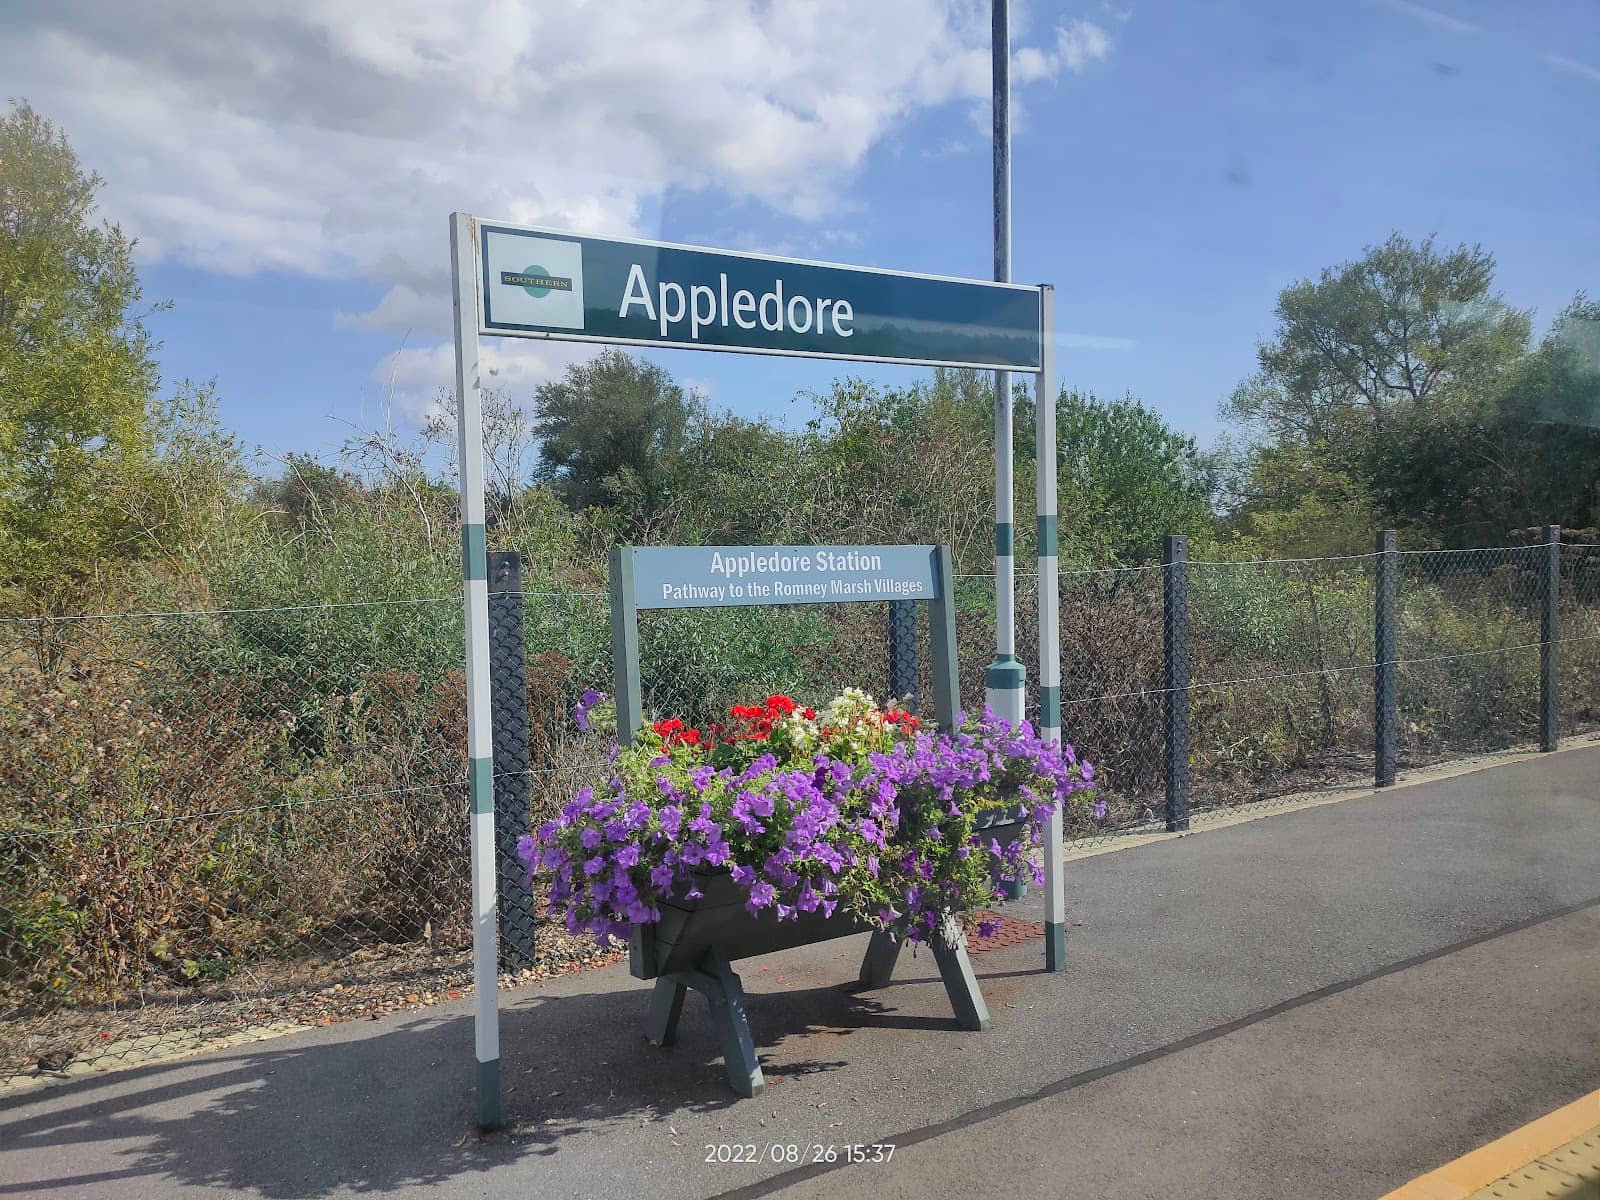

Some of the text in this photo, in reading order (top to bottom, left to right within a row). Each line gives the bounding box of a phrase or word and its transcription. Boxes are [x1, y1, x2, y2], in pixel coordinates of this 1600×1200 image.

[504, 275, 569, 288] SOUTHERN
[619, 264, 854, 339] Appledore
[710, 550, 881, 578] Appledore Station
[662, 578, 923, 601] Pathway to the Romney Marsh Villages
